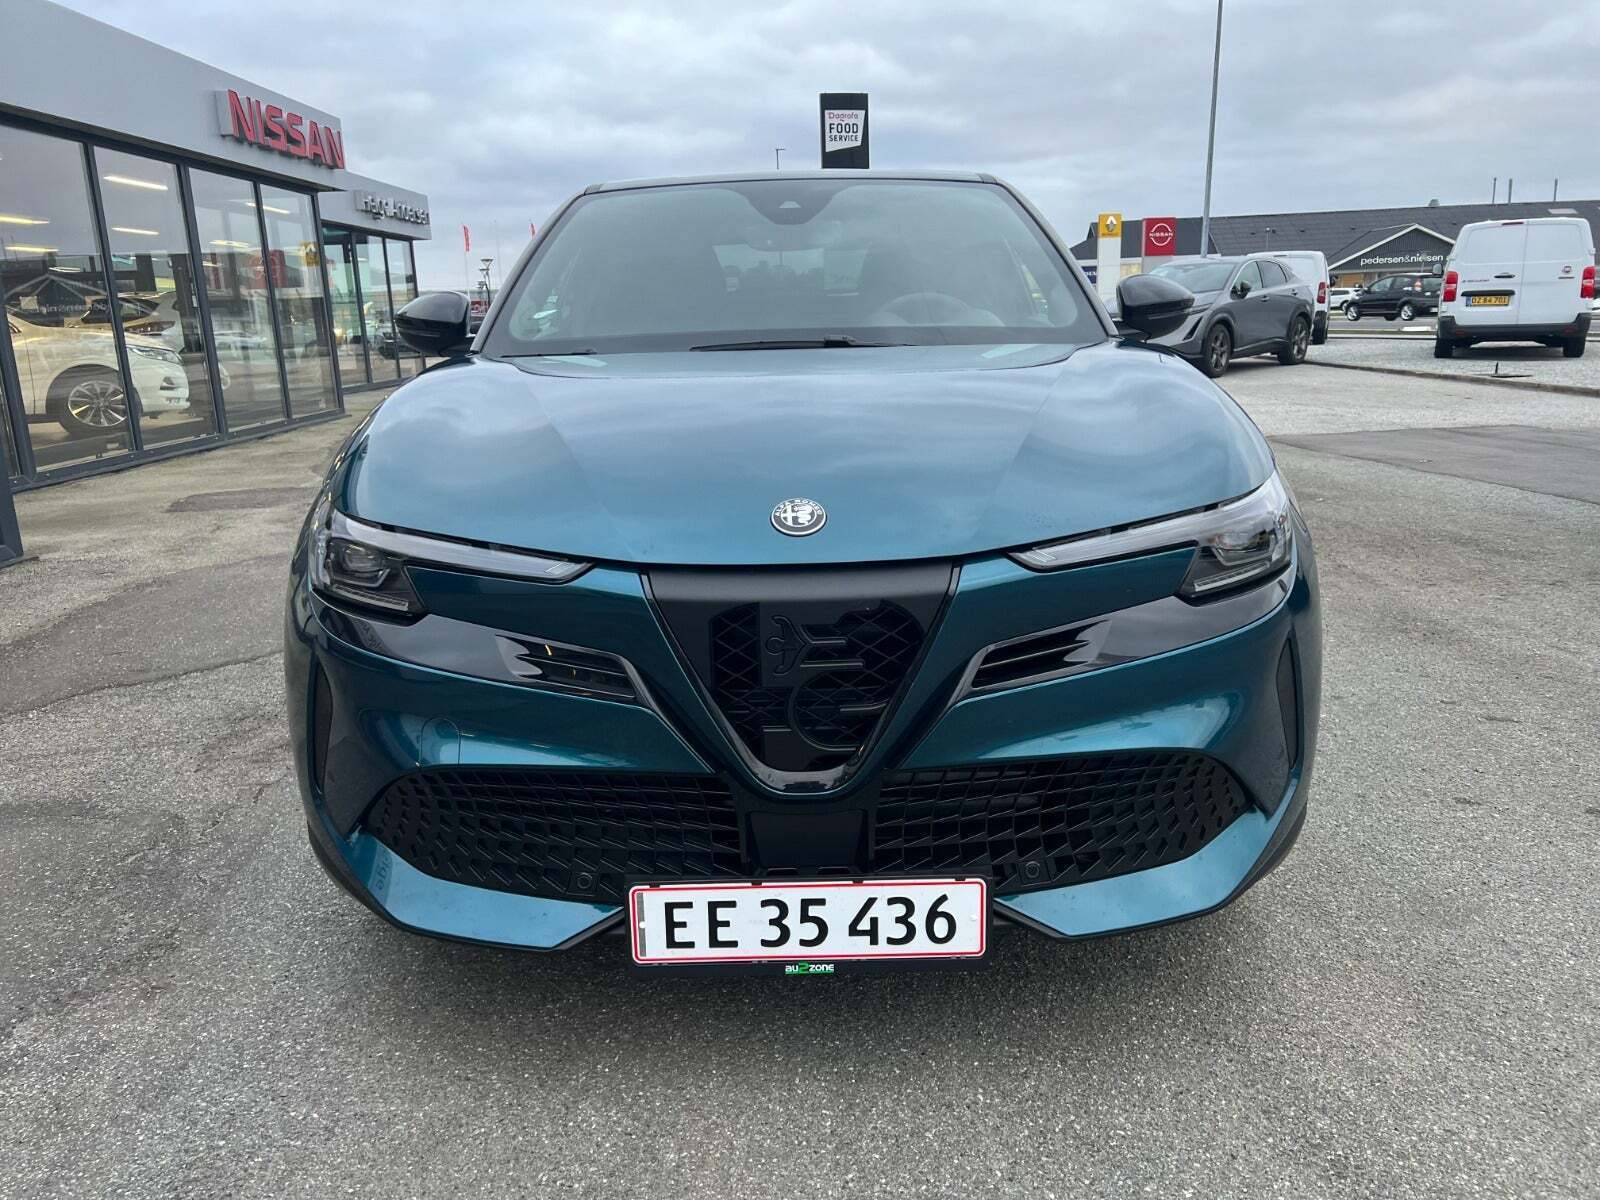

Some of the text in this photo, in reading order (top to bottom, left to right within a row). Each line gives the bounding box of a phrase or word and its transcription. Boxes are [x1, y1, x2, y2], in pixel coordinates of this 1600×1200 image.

[828, 111, 859, 122] Dagrofa
[227, 88, 345, 169] NISSAN
[829, 123, 859, 134] FOOD
[828, 134, 859, 142] SERVICE
[1360, 253, 1444, 267] pedersen&niesen
[664, 893, 957, 949] EE 35 436
[785, 961, 835, 974] au2zone
